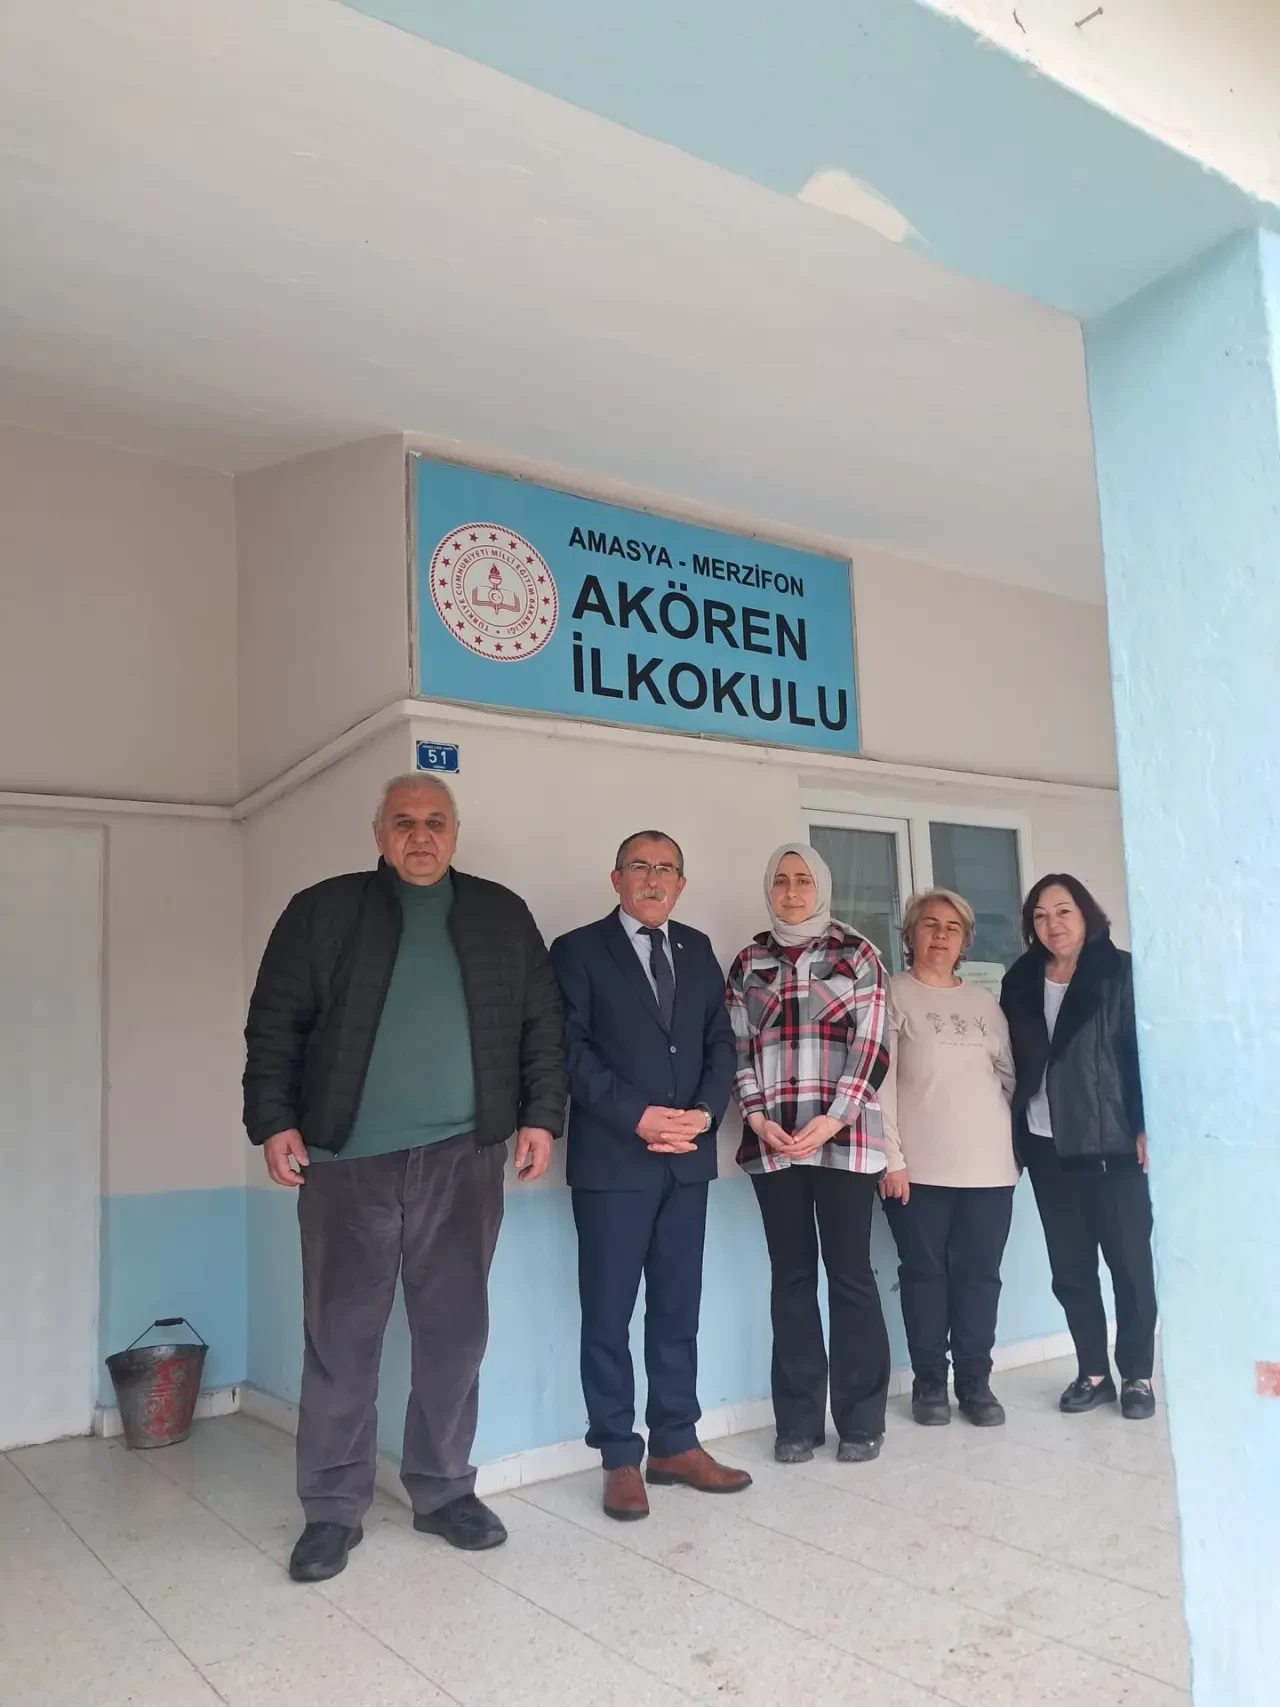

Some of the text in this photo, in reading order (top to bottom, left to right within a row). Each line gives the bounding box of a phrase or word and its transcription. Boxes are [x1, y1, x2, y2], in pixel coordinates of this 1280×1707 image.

[568, 527, 673, 570] AMASYA
[692, 554, 804, 598] MERZİFON
[571, 575, 808, 661] AKÖREN
[572, 631, 848, 731] İLKOKULU
[428, 749, 447, 765] 51
